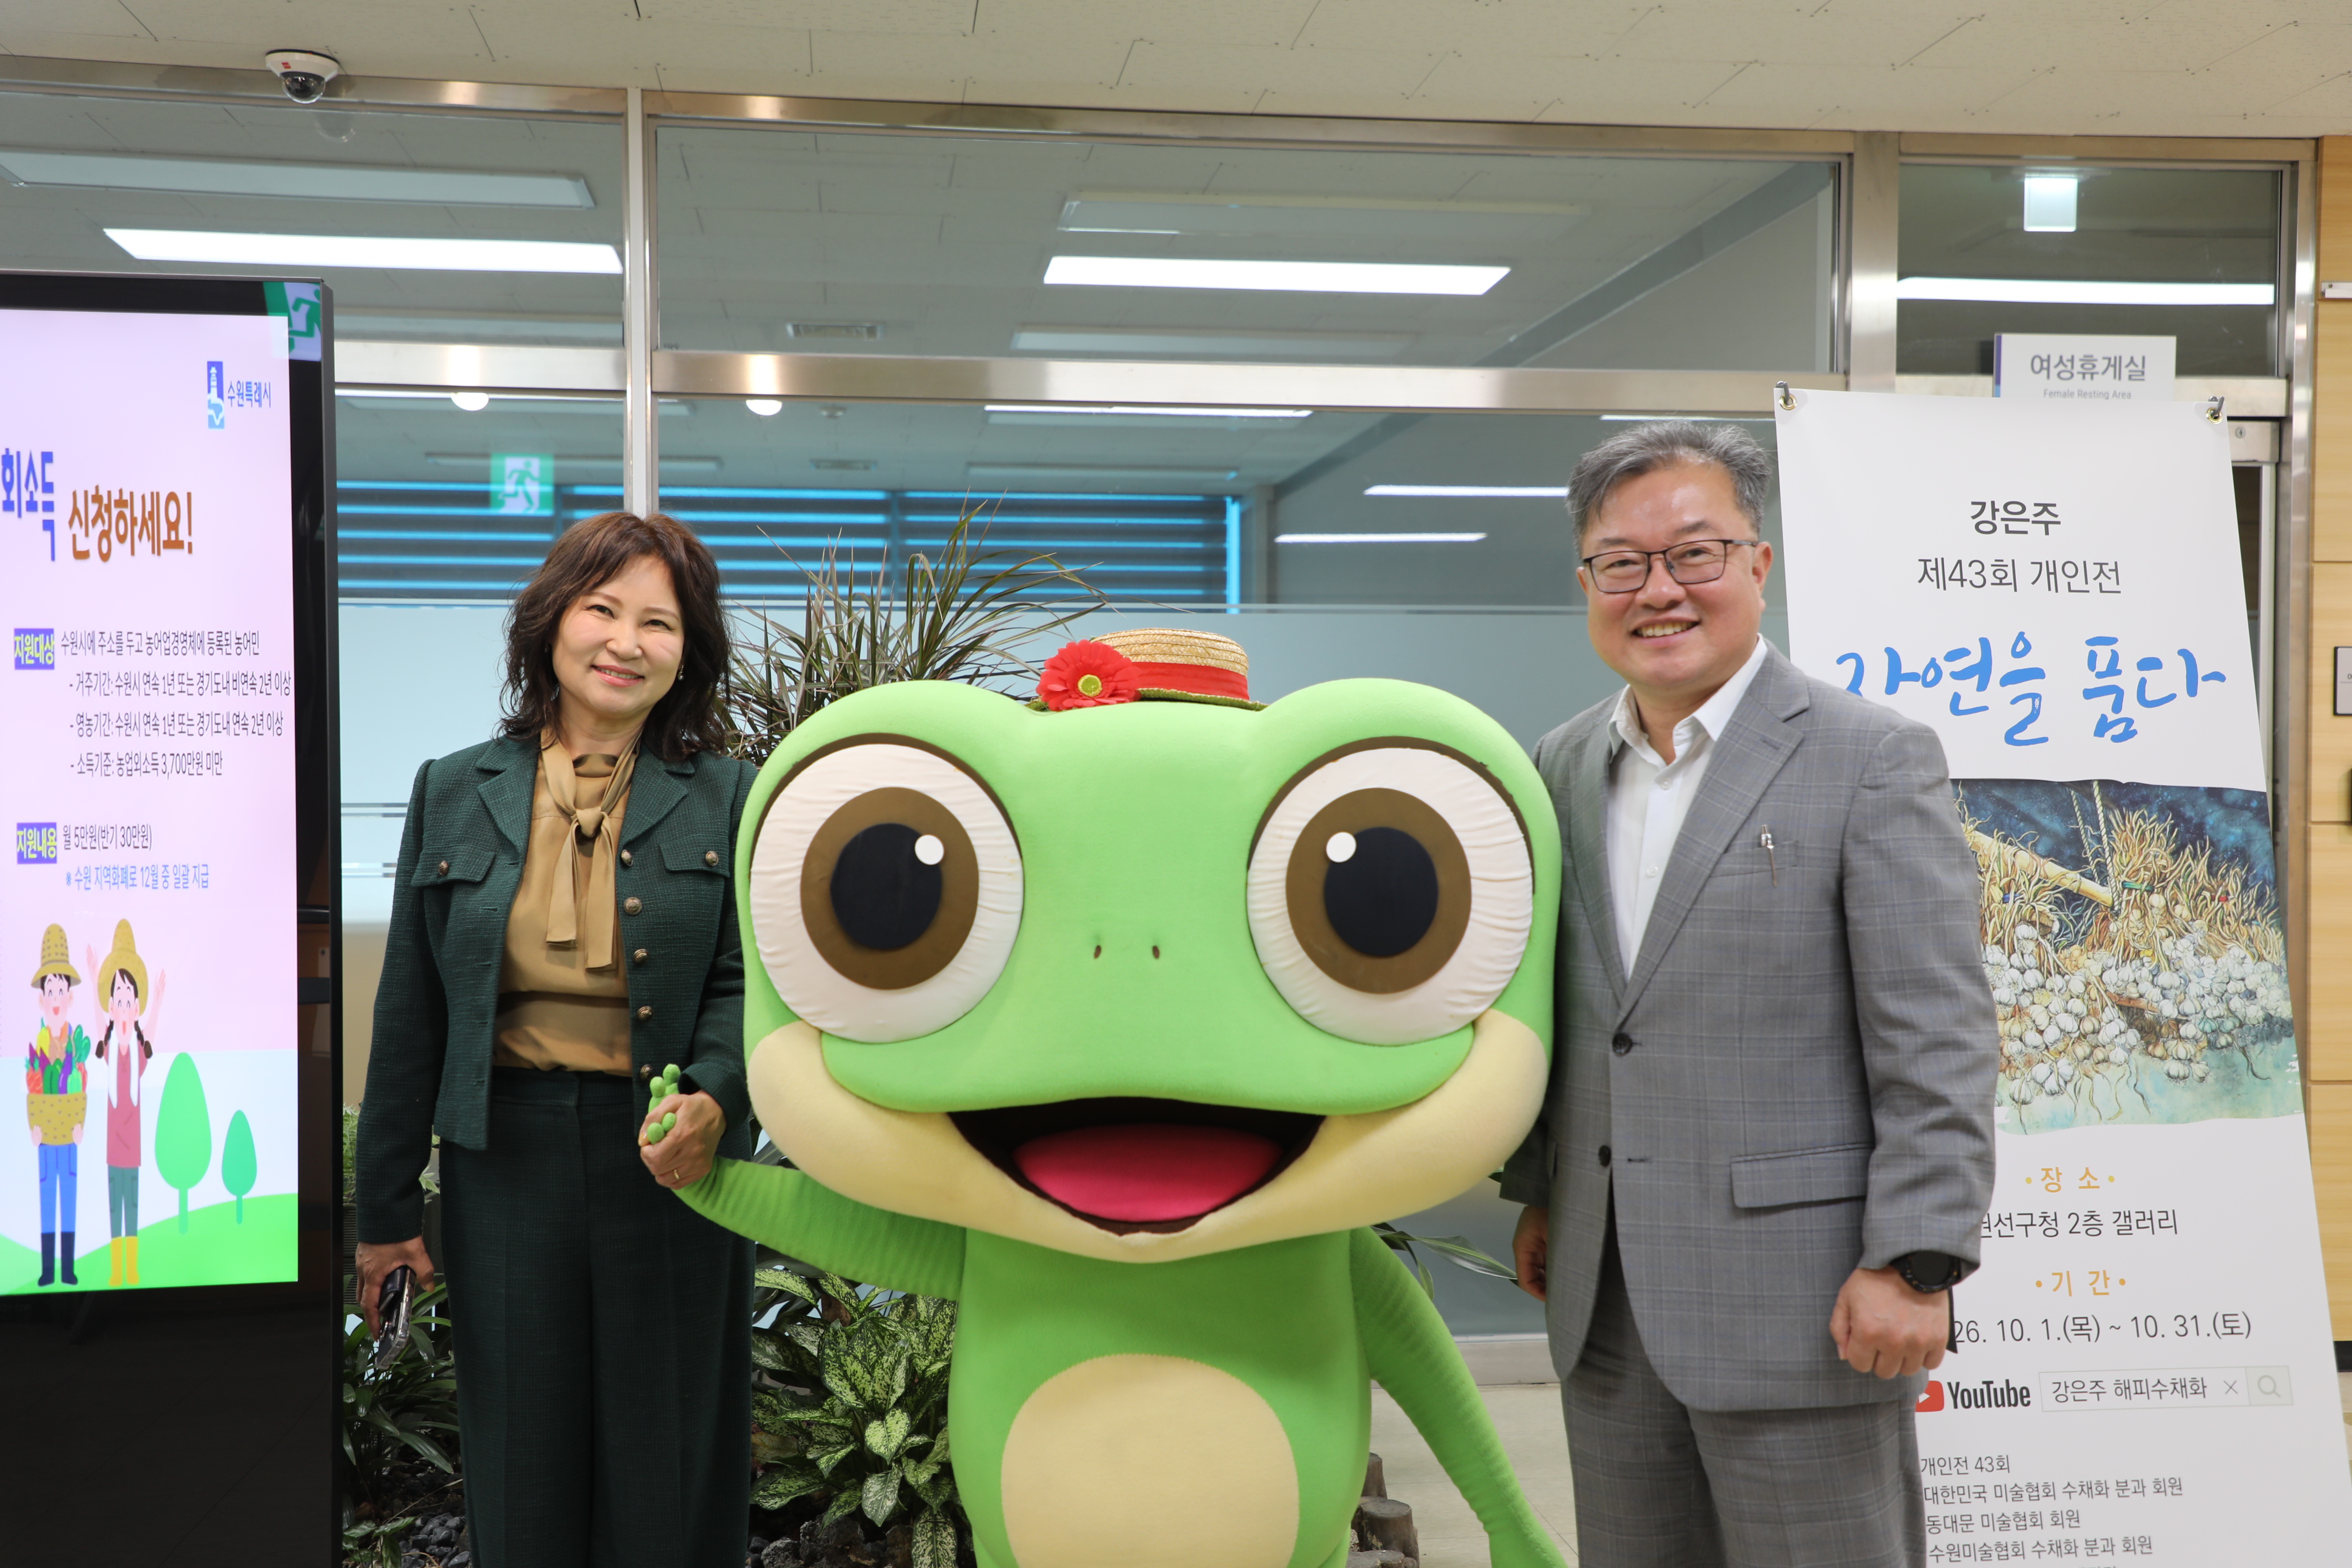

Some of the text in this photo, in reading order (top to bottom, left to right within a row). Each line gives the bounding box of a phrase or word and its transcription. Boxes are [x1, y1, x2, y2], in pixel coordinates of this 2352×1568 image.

[2030, 354, 2146, 381] 여성휴게실
[228, 380, 271, 407] 수원특례시
[2044, 388, 2131, 400] Female Resting Area
[68, 485, 192, 562] 신청하세요!
[1971, 501, 2061, 535] 강은주
[1918, 557, 2121, 594] 제43회 개인전
[15, 634, 54, 664] 지원대상
[62, 630, 259, 656] 수원시에 주소를 두고 농어업경영체에 등록된 농어민
[76, 671, 113, 697] 거주기간:
[115, 671, 140, 697] 수원시
[143, 671, 159, 696] 연속
[162, 671, 174, 695] 1년
[178, 672, 194, 695] 또는
[197, 671, 229, 696] 경기도내
[232, 671, 257, 696] 비연속
[259, 671, 271, 695] 2년
[275, 671, 291, 696] 이상
[1836, 632, 2226, 746] 자연을 품다
[76, 712, 113, 737] 영농기간:
[115, 712, 140, 737] 수원시
[143, 712, 159, 737] 연속
[162, 712, 174, 736] 1년
[178, 712, 194, 736] 또는
[197, 711, 230, 736] 경기도내
[232, 711, 249, 736] 연속
[251, 711, 263, 736] 2년
[267, 711, 283, 736] 이상
[77, 751, 114, 777] 소득기준:
[116, 751, 159, 777] 농업외소득
[162, 751, 203, 780] 3,700만원
[206, 751, 222, 776] 미만
[17, 828, 57, 858] 지원내용
[63, 824, 152, 851] 월 5만원(반기 30만원)
[75, 865, 91, 890] 수원
[95, 864, 137, 889] 지역화폐로
[140, 864, 158, 889] 12월
[162, 864, 169, 889] 중
[173, 864, 189, 888] 일괄
[192, 864, 209, 888] 지급
[2068, 1211, 2103, 1237] 2층
[2113, 1210, 2177, 1235] 갤러리
[1997, 1319, 2030, 1341] 10.
[2131, 1315, 2164, 1338] 10.
[2174, 1312, 2251, 1339] 31.(토)
[1947, 1379, 2031, 1409] YouTube
[2052, 1377, 2207, 1403] 강은주 해피수채화
[1920, 1455, 2010, 1476] 개인전 43회
[1924, 1477, 2182, 1505] 대한민국 미술협회 수채화 분과 회원
[1926, 1510, 2080, 1535] 동대문 미술협회 회원
[1929, 1536, 2152, 1564] 수원미술협회 수채화 분과 회원
